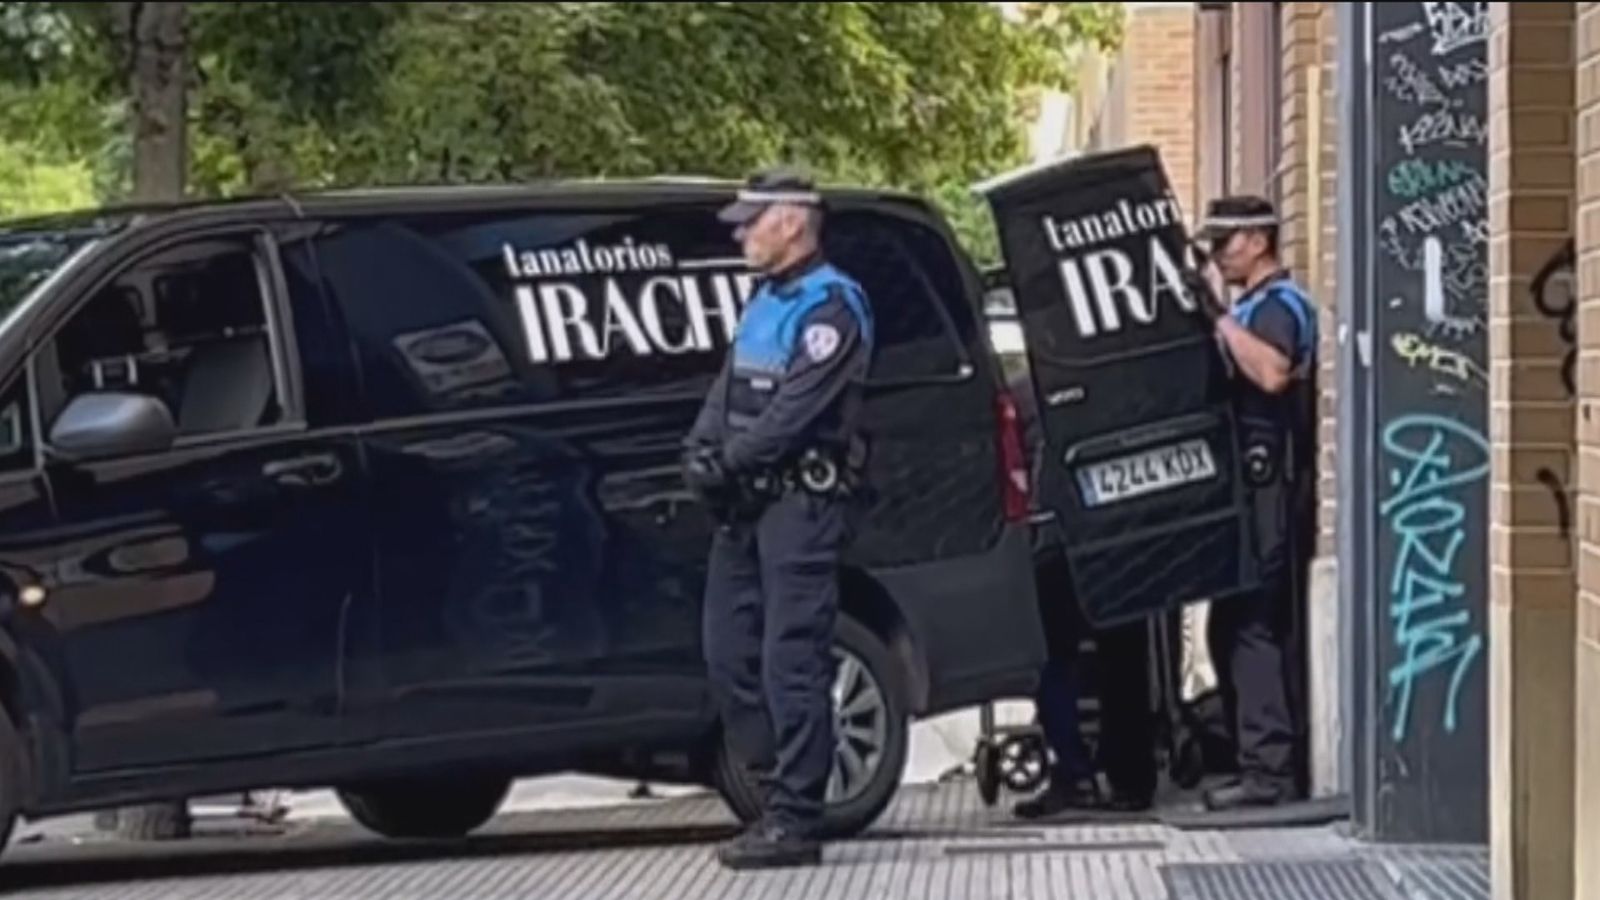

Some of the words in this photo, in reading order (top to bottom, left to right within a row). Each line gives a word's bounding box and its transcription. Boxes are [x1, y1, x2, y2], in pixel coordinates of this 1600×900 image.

[503, 236, 673, 277] tanatorios
[1060, 236, 1197, 337] IRA
[1100, 458, 1160, 494] 4244
